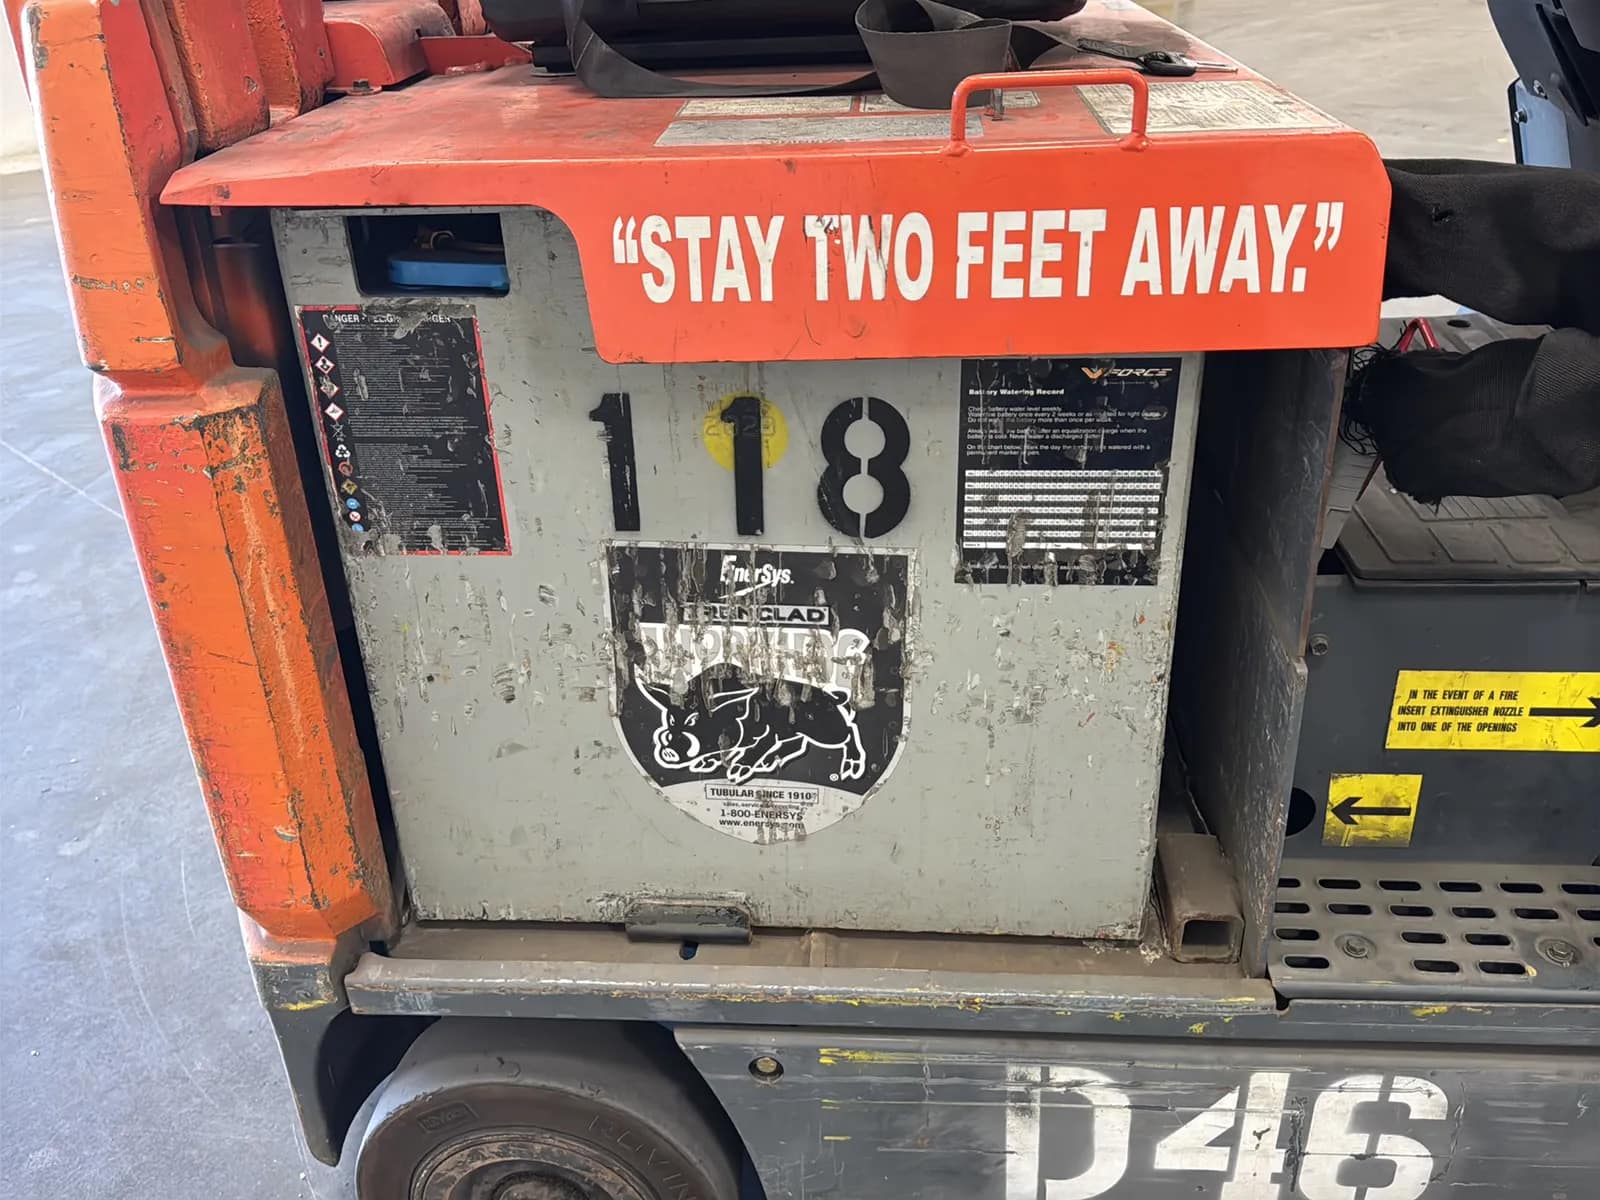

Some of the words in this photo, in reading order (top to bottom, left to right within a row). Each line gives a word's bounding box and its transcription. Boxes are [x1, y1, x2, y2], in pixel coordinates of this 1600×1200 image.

[804, 212, 934, 301] TWO
[955, 208, 1107, 299] FEET
[1000, 388, 1034, 397] Watering
[1036, 388, 1065, 396] Record
[1409, 690, 1418, 700] IN
[1423, 690, 1438, 700] THE
[1442, 690, 1469, 701] EVENT
[1473, 690, 1484, 700] OF
[1488, 690, 1495, 700] A
[1499, 690, 1520, 701] FIRE
[1398, 705, 1426, 716] INSERT
[1430, 706, 1489, 717] EXTINGUISHER
[1493, 706, 1524, 717] NOZZLE
[1397, 721, 1416, 732] INTO
[1421, 722, 1437, 732] ONE
[1441, 722, 1453, 732] OF
[1457, 722, 1472, 732] THE
[1476, 722, 1518, 733] OPENINGS
[710, 787, 754, 798] TUBULAR
[755, 788, 785, 799] SINCE
[788, 791, 812, 800] 1910
[720, 808, 803, 822] 1-800-ENERSYS
